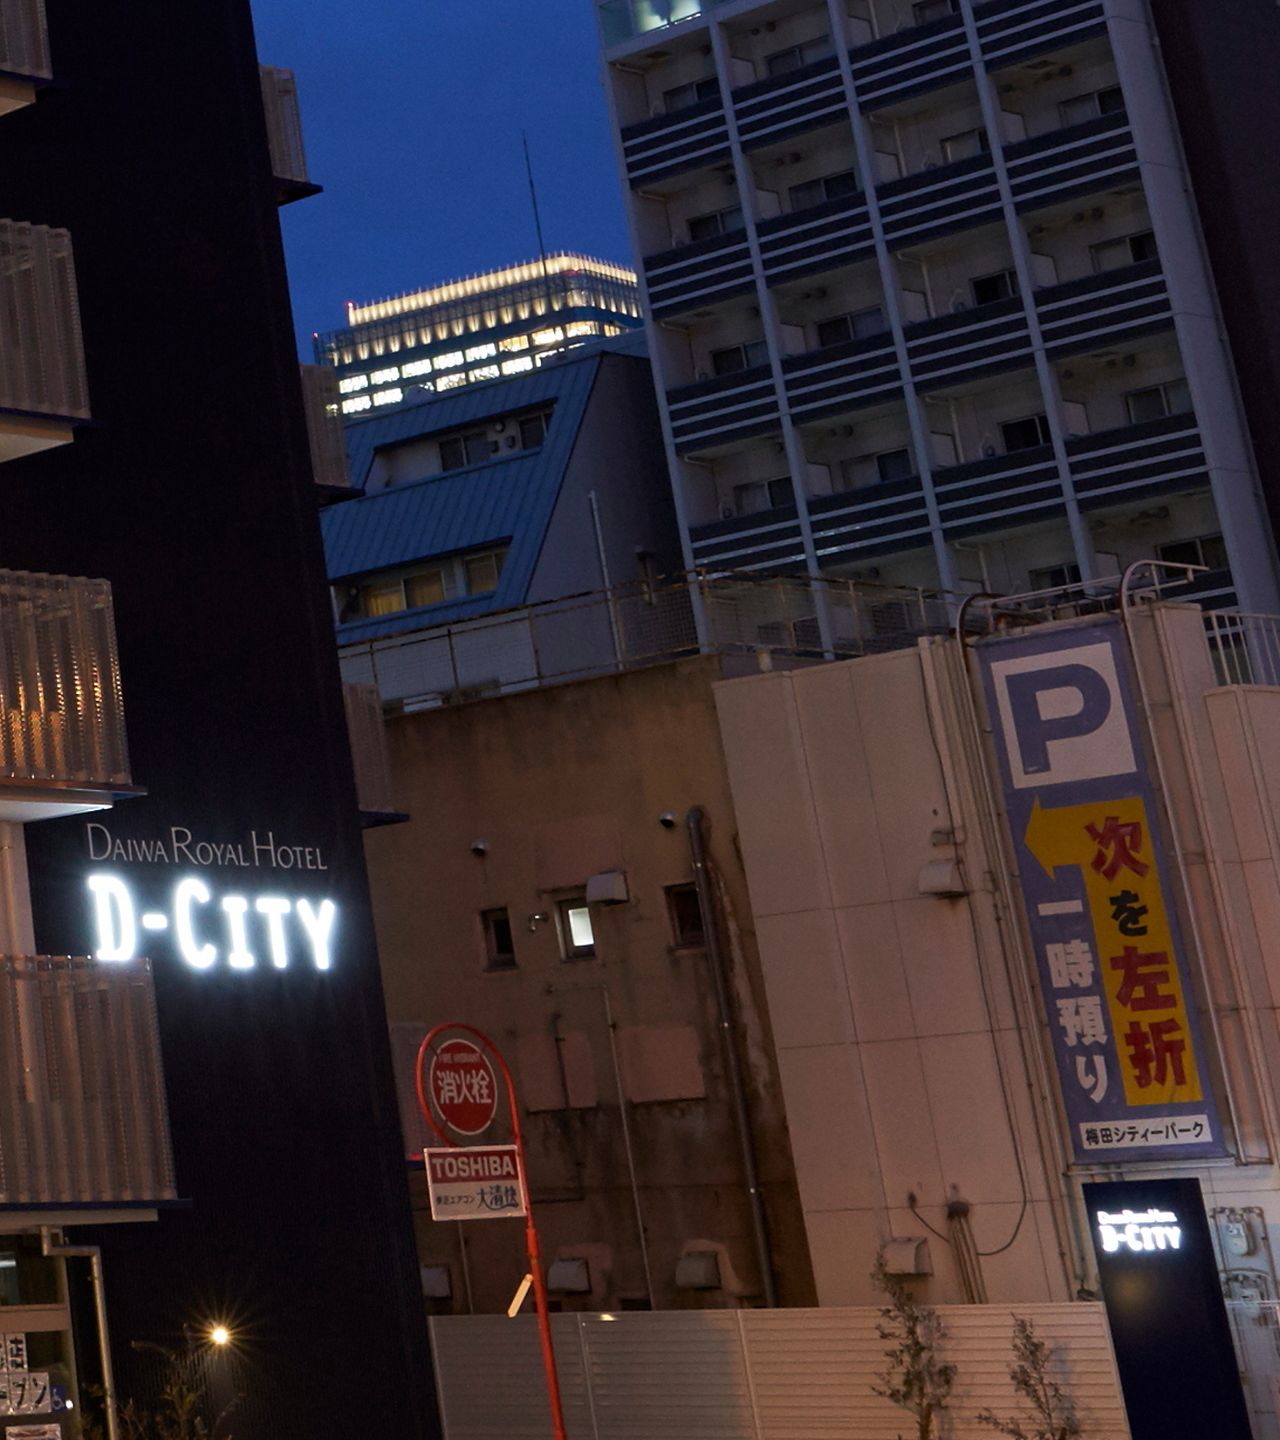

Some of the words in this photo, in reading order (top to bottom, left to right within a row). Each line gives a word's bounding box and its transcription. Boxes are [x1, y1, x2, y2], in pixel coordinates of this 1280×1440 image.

[1005, 663, 1111, 775] P
[87, 822, 169, 863] DAIWA
[171, 827, 250, 866] ROYAL
[251, 830, 328, 870] HOTEL
[87, 874, 336, 970] D-CITY
[1083, 816, 1187, 1089] 次を左折
[435, 1068, 492, 1105] 消火栓
[431, 1155, 515, 1179] TOSHIBA
